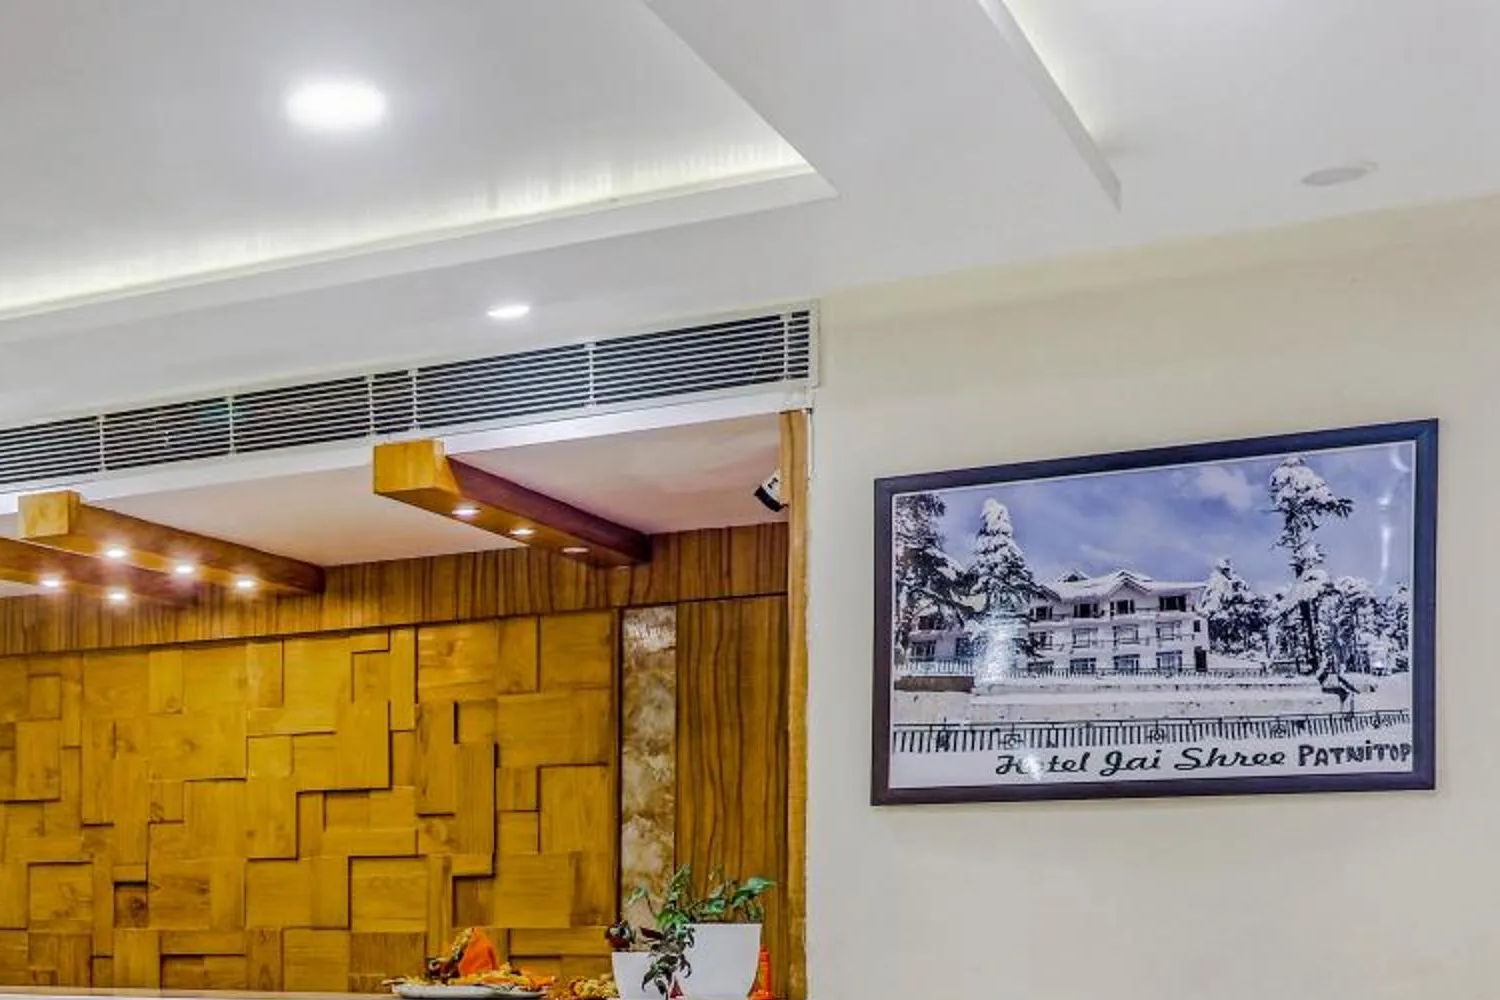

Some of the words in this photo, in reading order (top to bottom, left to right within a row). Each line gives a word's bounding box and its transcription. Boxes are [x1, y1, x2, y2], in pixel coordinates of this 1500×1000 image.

[995, 751, 1091, 775] Htel
[1100, 749, 1161, 777] Jai
[1174, 747, 1286, 771] Shree
